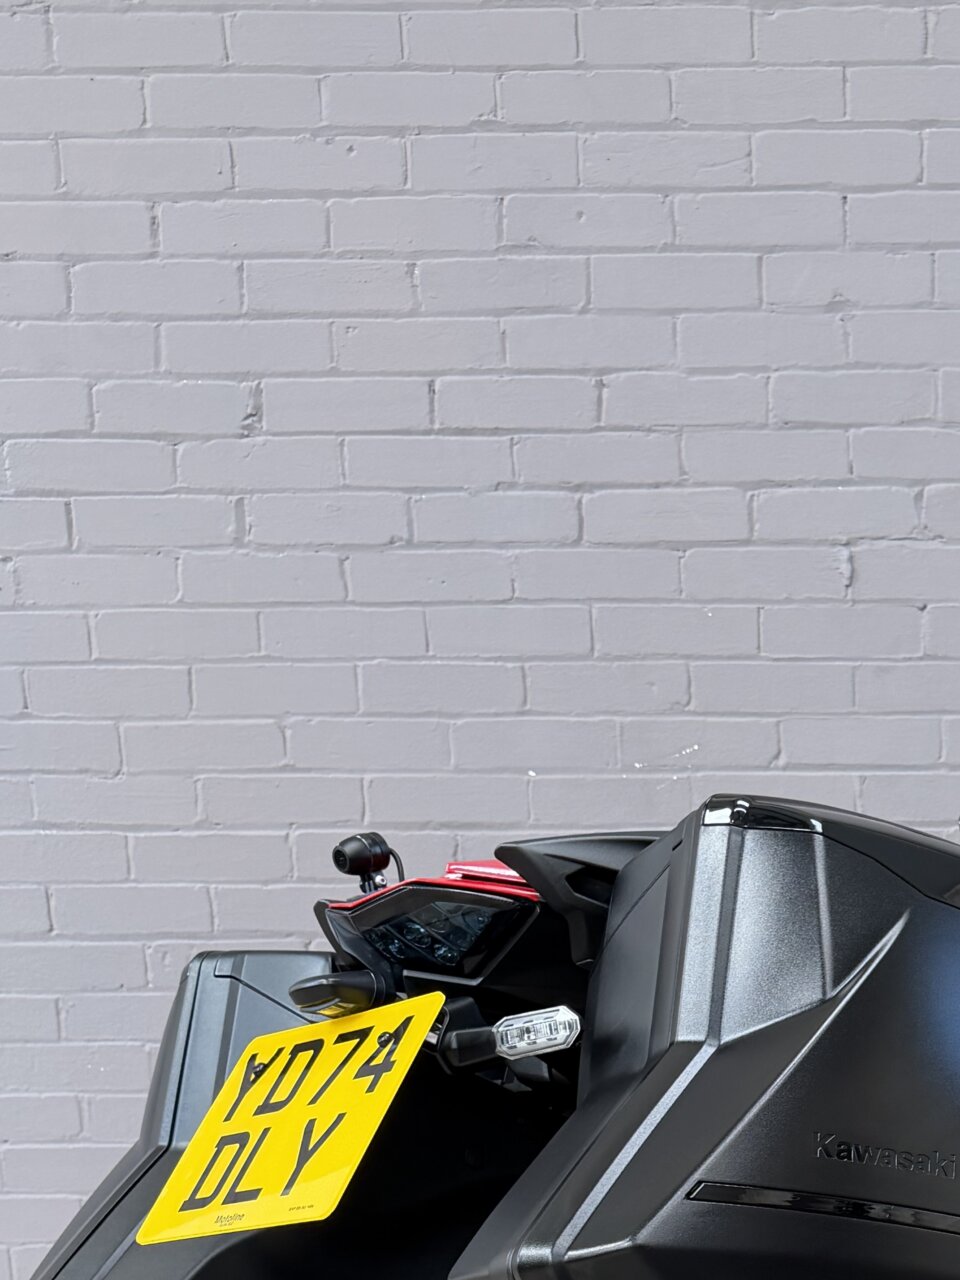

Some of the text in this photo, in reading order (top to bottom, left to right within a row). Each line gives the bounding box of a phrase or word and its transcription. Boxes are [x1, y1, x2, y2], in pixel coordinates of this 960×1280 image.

[223, 1015, 414, 1122] YD74
[178, 1112, 347, 1212] DLY
[813, 1131, 957, 1180] Kawasaki
